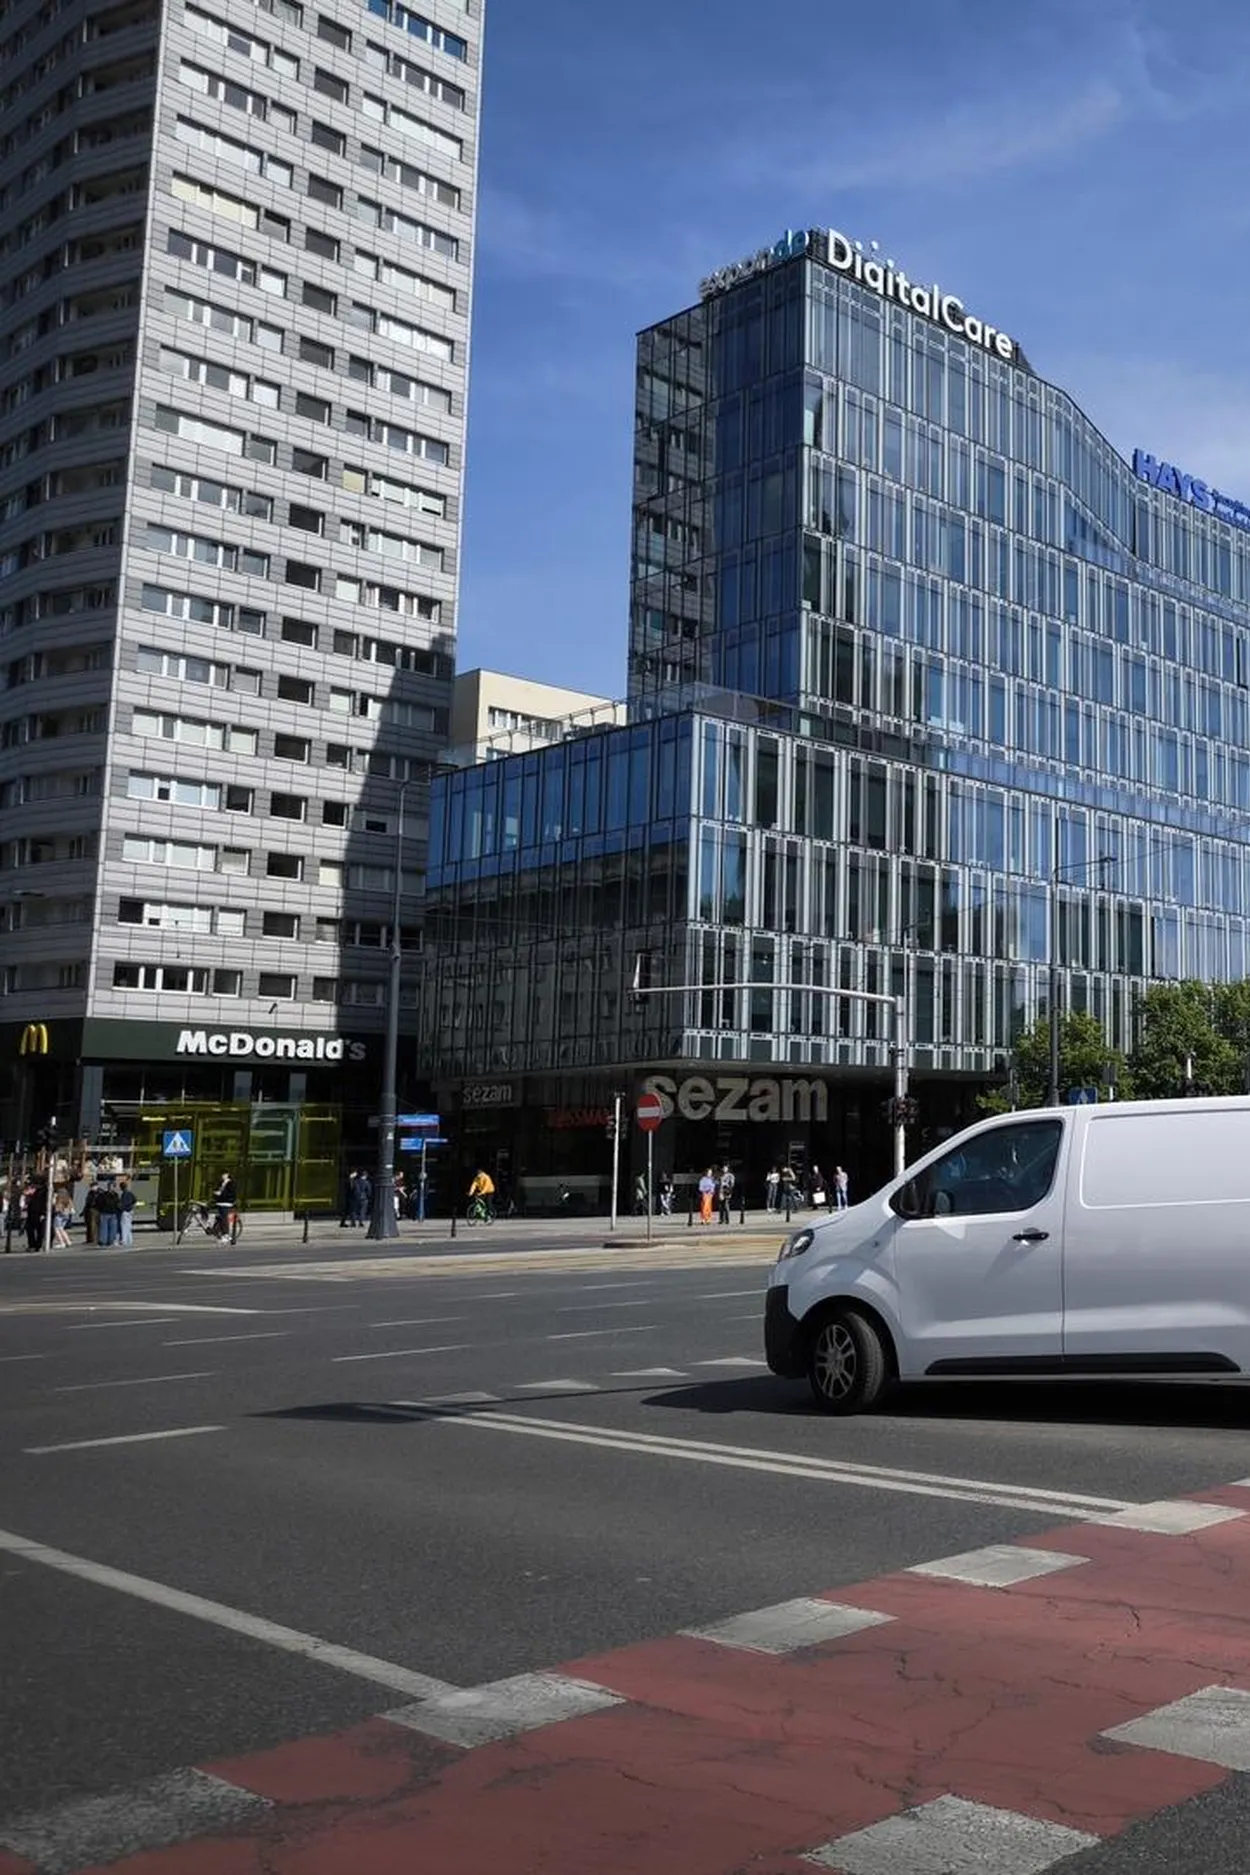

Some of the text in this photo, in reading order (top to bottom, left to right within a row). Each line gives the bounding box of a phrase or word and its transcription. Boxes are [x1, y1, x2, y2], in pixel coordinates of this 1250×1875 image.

[828, 228, 1013, 359] DigitalCare
[1132, 448, 1210, 509] HAYS
[176, 1030, 366, 1060] McDonald's
[462, 1083, 513, 1103] sezam
[644, 1075, 829, 1122] sezam
